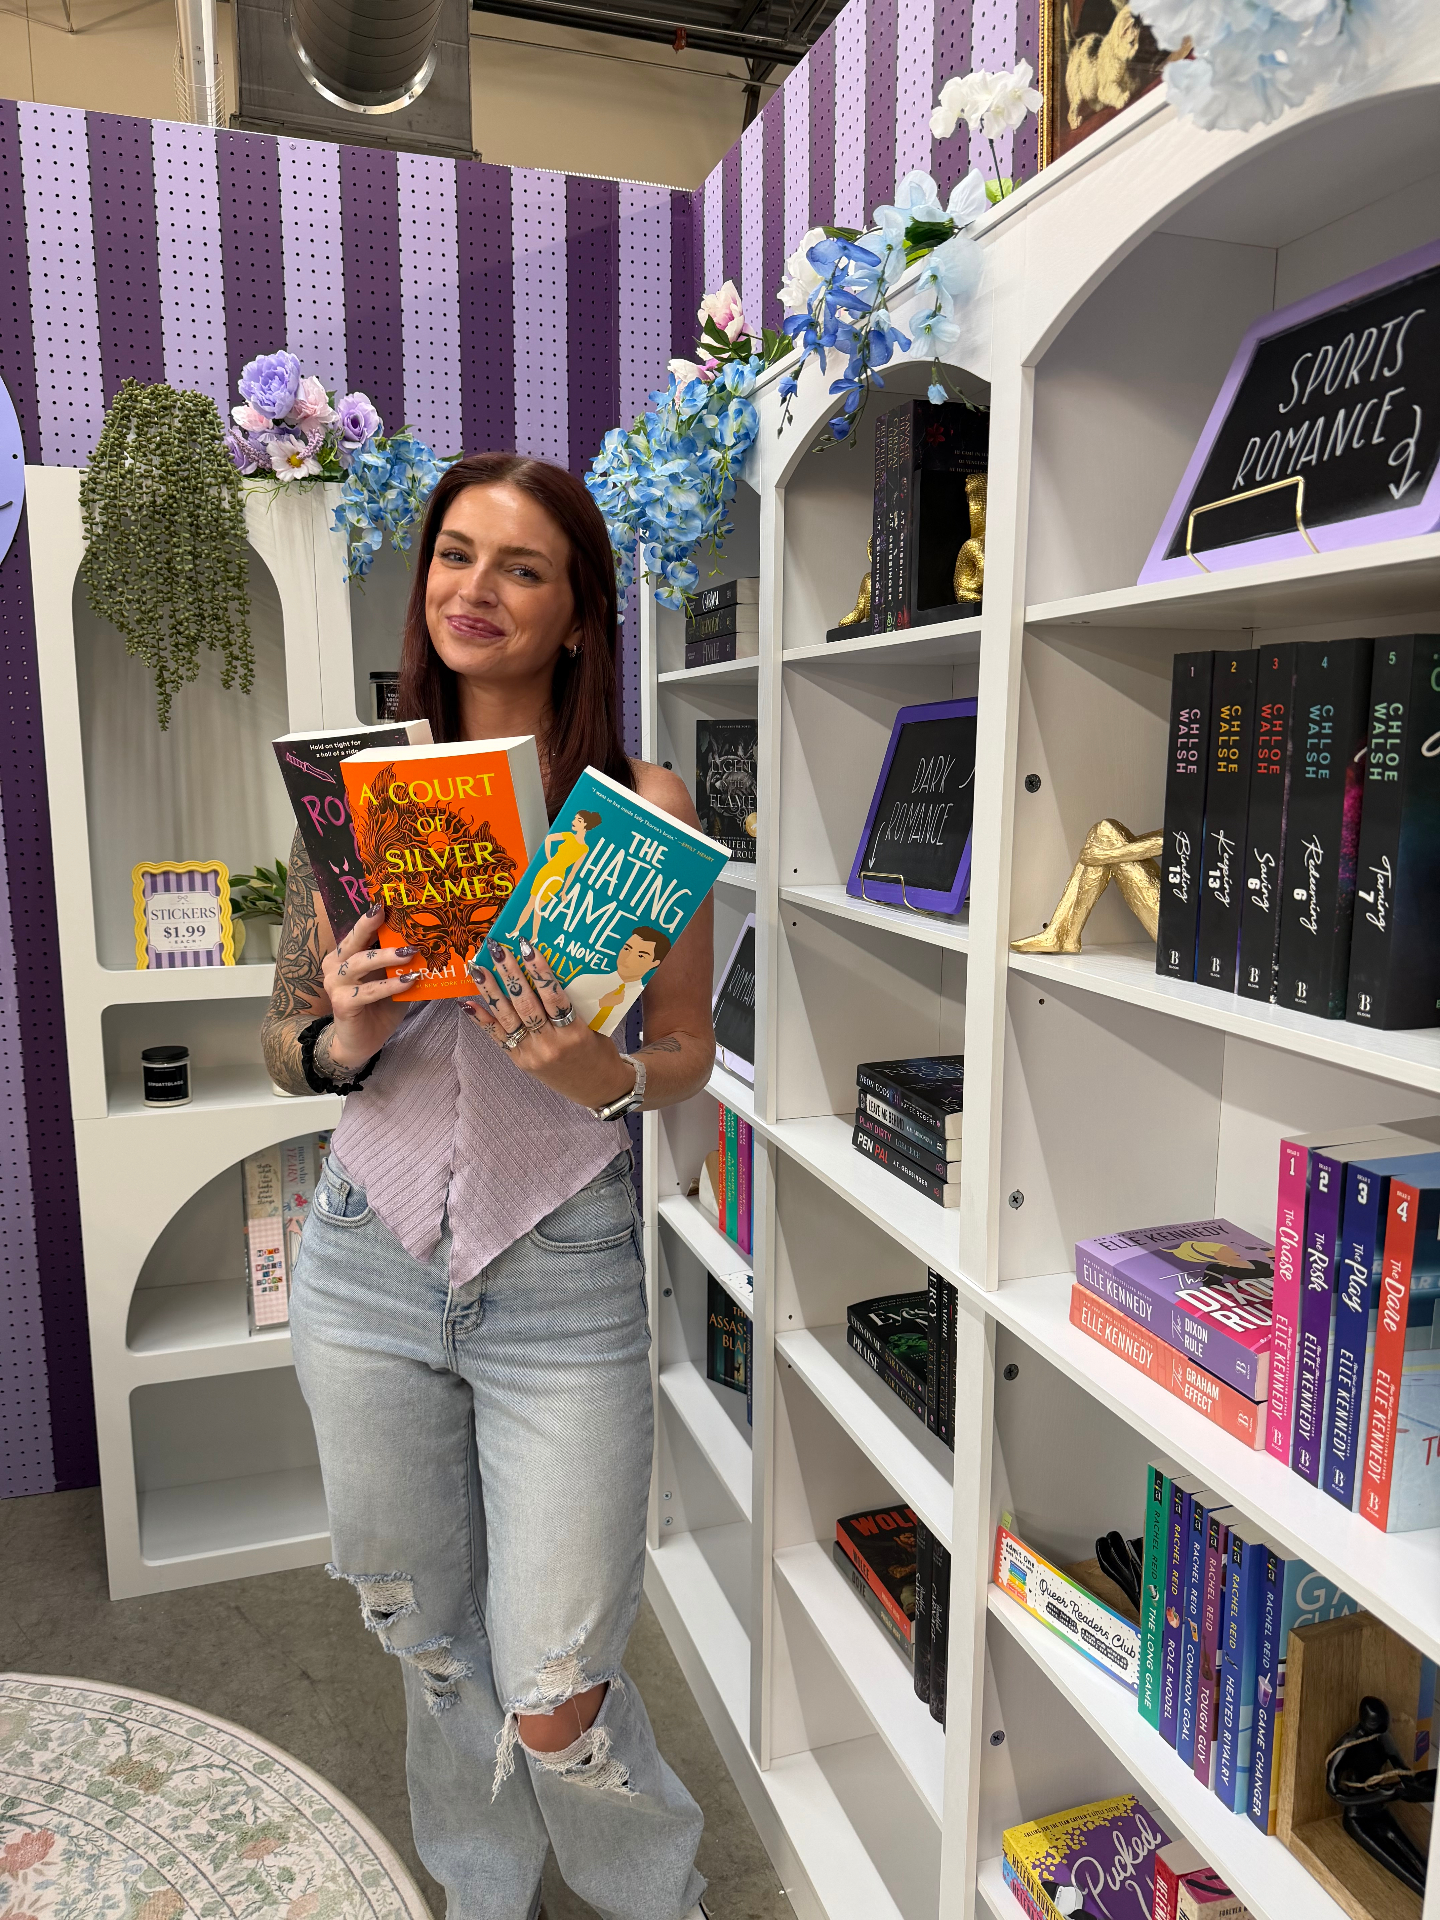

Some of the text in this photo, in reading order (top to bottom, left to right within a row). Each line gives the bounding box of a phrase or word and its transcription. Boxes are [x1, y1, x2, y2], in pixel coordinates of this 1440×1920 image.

[1279, 309, 1426, 414] SPORTS
[1232, 387, 1406, 490] ROMANCE
[1190, 666, 1195, 678] 1
[1230, 661, 1237, 673] 2
[1272, 658, 1279, 670] 3
[1321, 656, 1328, 669] 4
[1388, 652, 1396, 665] 5
[1176, 709, 1190, 774] WALSH
[1187, 708, 1200, 774] CHLOE
[1217, 705, 1232, 772] WALSH
[1228, 706, 1242, 773] CHLOE
[1257, 704, 1272, 774] WALSH
[1269, 704, 1284, 774] CHLOE
[1305, 704, 1321, 780] WALSH
[1318, 705, 1334, 780] CHLOE
[1368, 702, 1388, 781] WALSH
[1384, 702, 1404, 782] CHLOE
[358, 773, 495, 806] A COURT
[912, 754, 956, 794] DARK
[416, 816, 445, 834] OF
[620, 806, 634, 816] inside
[634, 814, 644, 823] Sally
[696, 850, 714, 862] HENRY
[884, 801, 954, 846] ROMANCE
[385, 842, 497, 874] SILVER
[630, 830, 668, 868] THE
[1172, 830, 1192, 903] Binding
[1211, 830, 1236, 908] Keeping
[382, 872, 514, 906] FLAMES
[580, 836, 692, 934] HATING
[1168, 865, 1180, 884] 13
[1208, 869, 1220, 888] 13
[1248, 878, 1260, 890] 6
[1252, 848, 1275, 913] Saving
[1293, 888, 1308, 901] 6
[1300, 834, 1324, 935] Redeeming
[1358, 890, 1374, 904] 7
[1366, 855, 1392, 933] Taming
[150, 906, 217, 922] STICKERS
[163, 924, 206, 940] $1.99
[534, 876, 638, 956] GAME
[396, 964, 456, 982] SRAH
[554, 934, 566, 948] A
[566, 942, 610, 972] NOVEL
[860, 1116, 873, 1131] PLAY
[874, 1123, 892, 1142] DIRTY
[868, 1099, 880, 1118] LEAVE
[858, 1132, 874, 1153] PEN
[874, 1144, 888, 1164] PAL
[1289, 1157, 1296, 1176] 1
[300, 1166, 308, 1184] who
[1318, 1170, 1329, 1194] 2
[1357, 1182, 1368, 1205] 3
[1396, 1202, 1408, 1222] 4
[1098, 1224, 1230, 1252] ELLE KENNEDY
[1278, 1209, 1299, 1282] The Chase
[1159, 1269, 1210, 1290] The
[1307, 1232, 1330, 1292] The Risk
[1342, 1242, 1368, 1313] The Play
[1390, 1260, 1402, 1280] The
[1084, 1264, 1152, 1323] ELLE KENNEDY
[1174, 1277, 1274, 1313] DIXO
[1081, 1307, 1154, 1369] ELLE KENNEDY
[1172, 1309, 1184, 1342] The
[1184, 1318, 1208, 1344] DIXON
[1184, 1334, 1204, 1358] RULE
[852, 1334, 880, 1372] PRAISE
[1172, 1358, 1184, 1390] The
[1271, 1314, 1288, 1420] ELLE KENNEDY
[1184, 1384, 1212, 1414] EFFECT
[1186, 1368, 1220, 1400] GRAHAM
[1298, 1332, 1318, 1442] ELLE KENNEDY
[1332, 1348, 1354, 1462] ELLE KENNEDY
[1367, 1368, 1391, 1484] ELLE KENNEDY
[1024, 1556, 1034, 1568] One
[1151, 1510, 1161, 1580] RACHEL REID
[1171, 1524, 1182, 1596] RACHEL REID
[1190, 1542, 1200, 1615] RACHEL REID
[1206, 1557, 1216, 1632] RACHEL REID
[1039, 1578, 1068, 1608] Queer
[1070, 1600, 1110, 1640] Readers
[1112, 1634, 1136, 1658] Club
[1229, 1573, 1240, 1650] RACHEL REID
[1264, 1592, 1274, 1669] RACHEL REID
[1144, 1606, 1156, 1710] THE LONG GAME
[1164, 1638, 1176, 1719] ROLE MODEL
[1182, 1644, 1195, 1741] COMMON GOAL
[1196, 1686, 1210, 1764] TOUGH GUY
[1221, 1674, 1235, 1786] HEATED RIVALRY
[1252, 1708, 1268, 1817] GAME CHANGER
[1058, 1819, 1070, 1828] TEAM
[1106, 1805, 1120, 1814] SISTER
[1012, 1854, 1035, 1898] HELENA
[1071, 1814, 1162, 1920] Pucked
[1219, 1906, 1242, 1917] FOREVER
